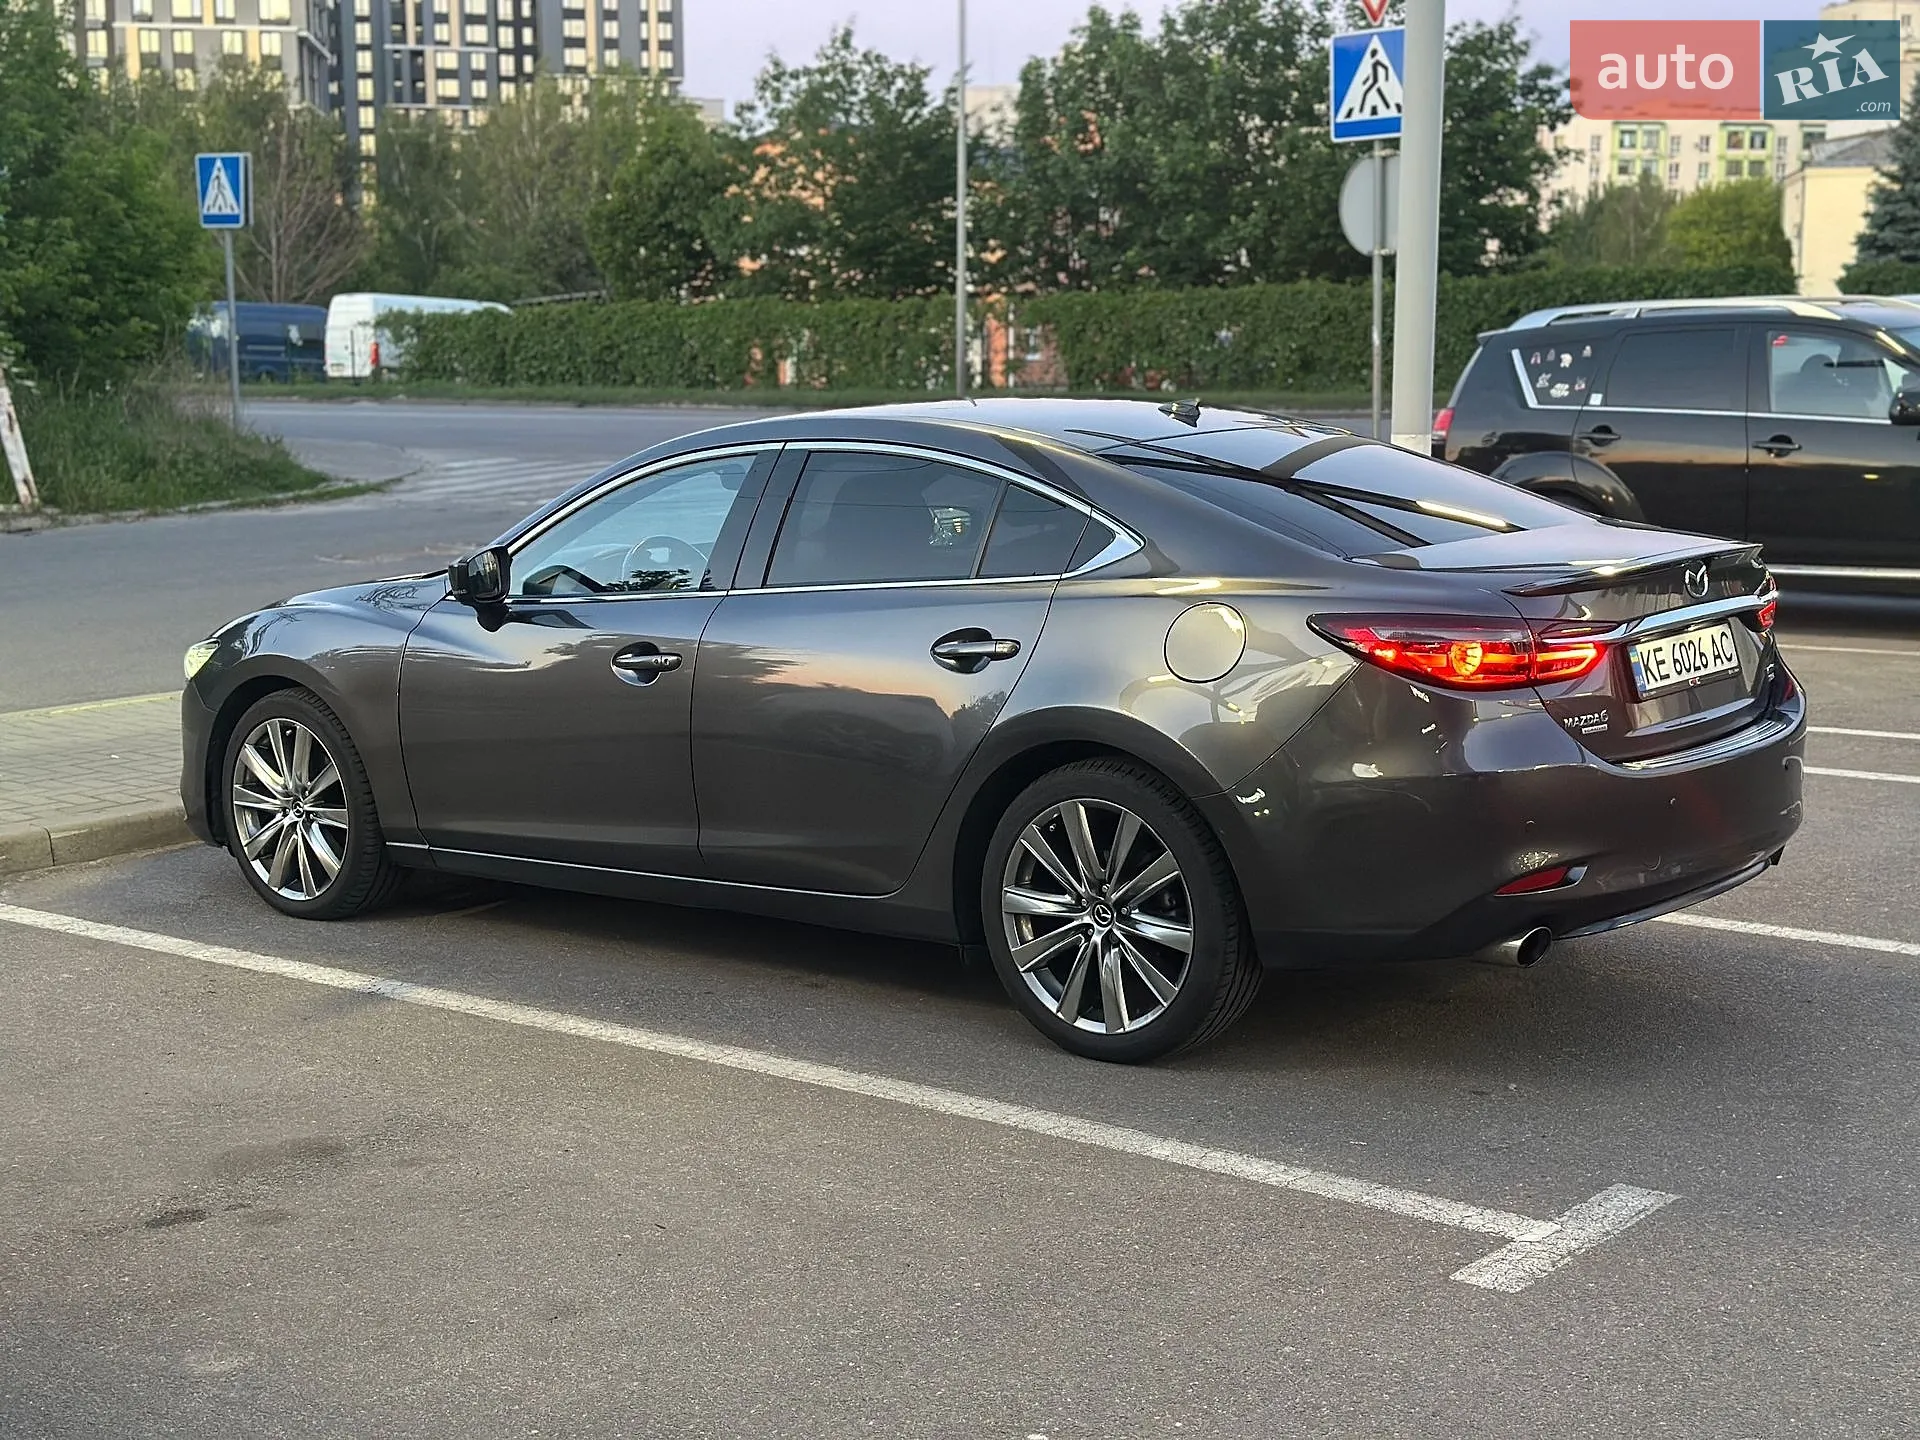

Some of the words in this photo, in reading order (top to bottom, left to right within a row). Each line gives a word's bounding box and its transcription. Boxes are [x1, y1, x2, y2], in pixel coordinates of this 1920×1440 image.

[1640, 647, 1670, 684] KE
[1672, 637, 1709, 675] 6026
[1711, 631, 1733, 667] AC
